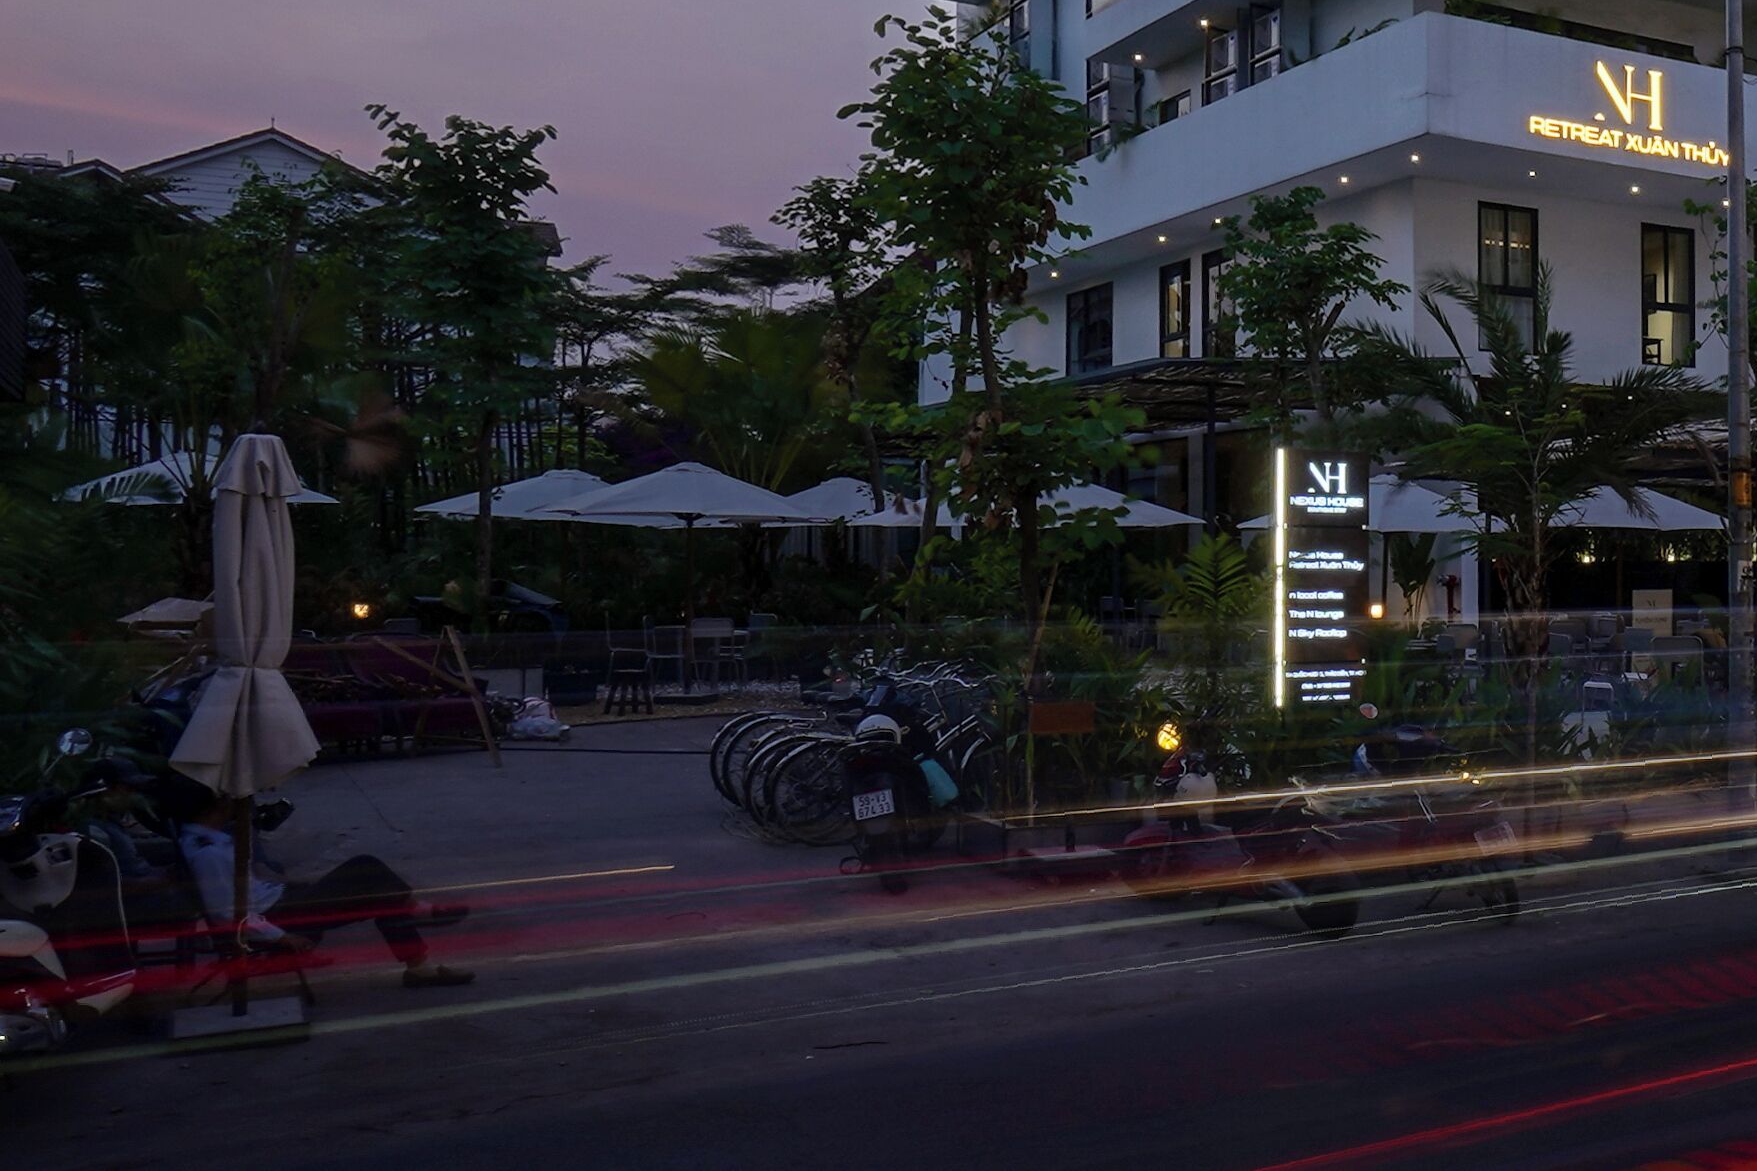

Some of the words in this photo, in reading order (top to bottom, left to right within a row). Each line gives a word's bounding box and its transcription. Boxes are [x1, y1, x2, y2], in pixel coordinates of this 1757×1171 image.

[1529, 115, 1623, 148] RETREAT
[1289, 496, 1326, 507] NEXUS
[1327, 497, 1364, 508] HOUSE
[1288, 610, 1306, 618] The
[1306, 610, 1314, 618] N
